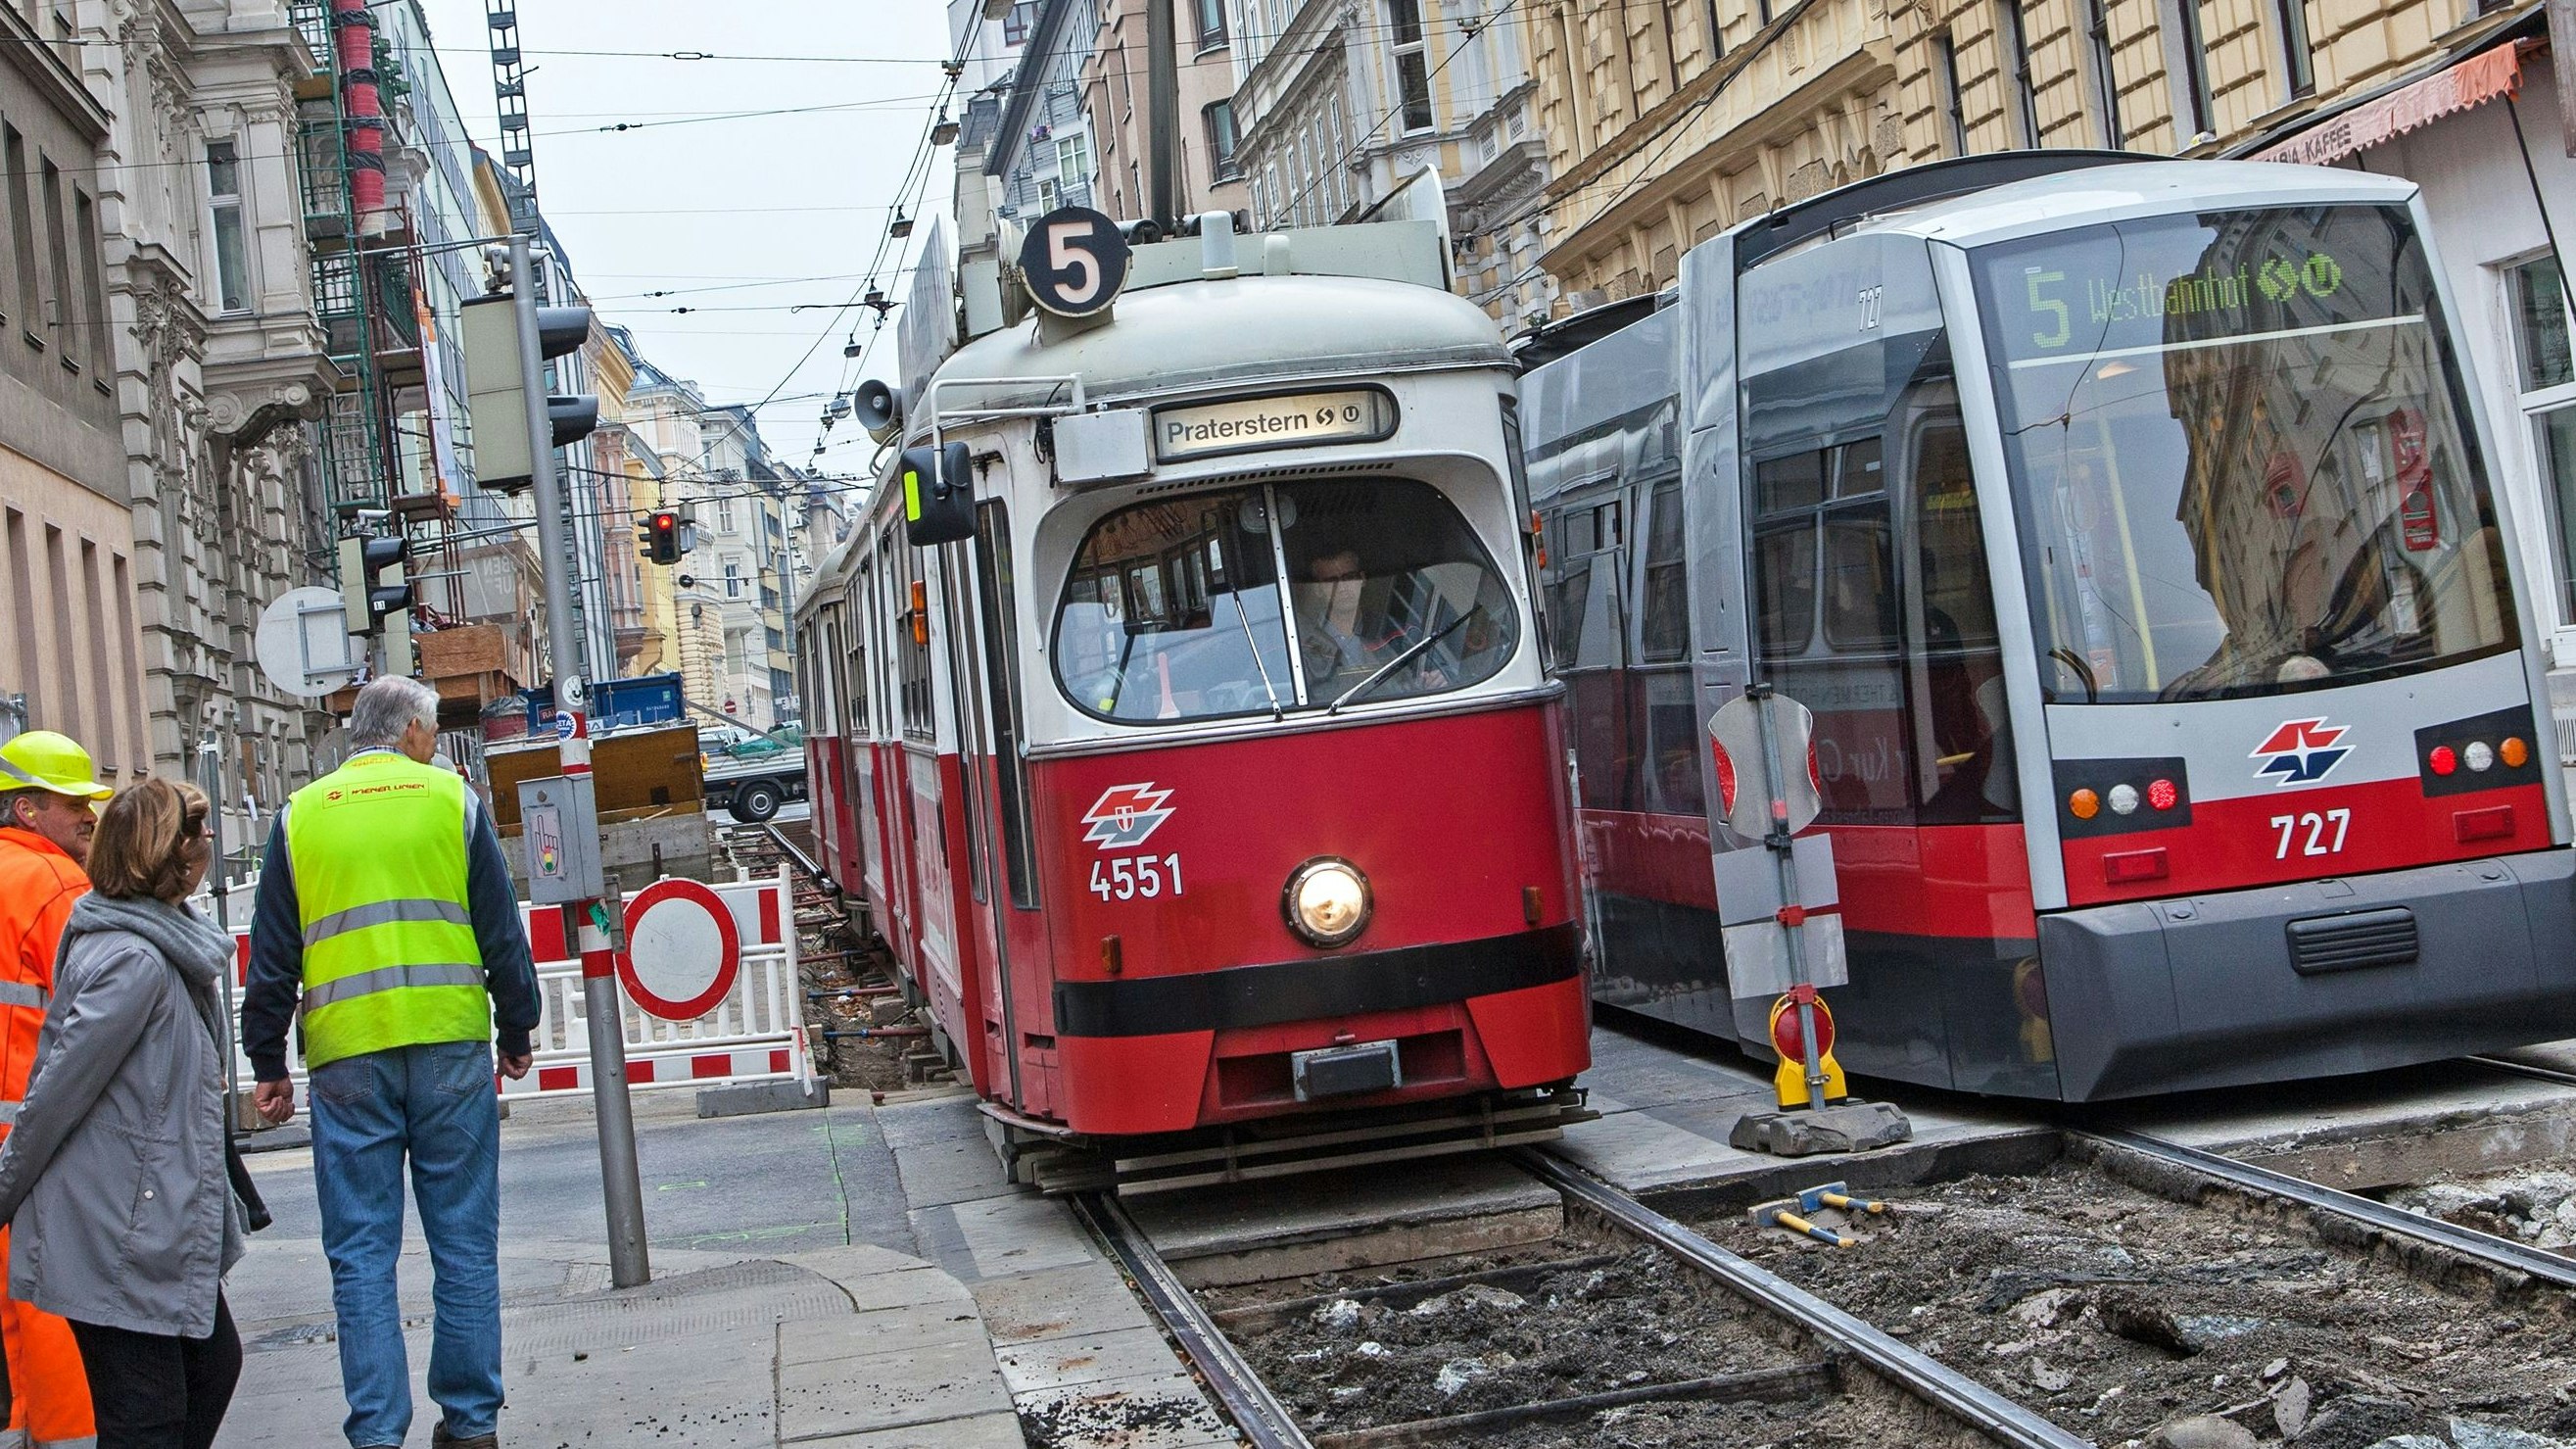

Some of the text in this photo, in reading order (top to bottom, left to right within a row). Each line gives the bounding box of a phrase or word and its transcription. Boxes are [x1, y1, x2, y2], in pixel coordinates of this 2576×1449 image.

[2305, 122, 2352, 162] KAFFEE
[1048, 221, 1100, 304] 5
[1859, 284, 1884, 332] 727
[2027, 270, 2071, 348] 5
[2088, 264, 2250, 323] Westbahnhof
[1168, 413, 1309, 443] Praterstern
[352, 786, 391, 796] WIENER
[2270, 807, 2351, 859] 727
[1089, 852, 1183, 901] 4551
